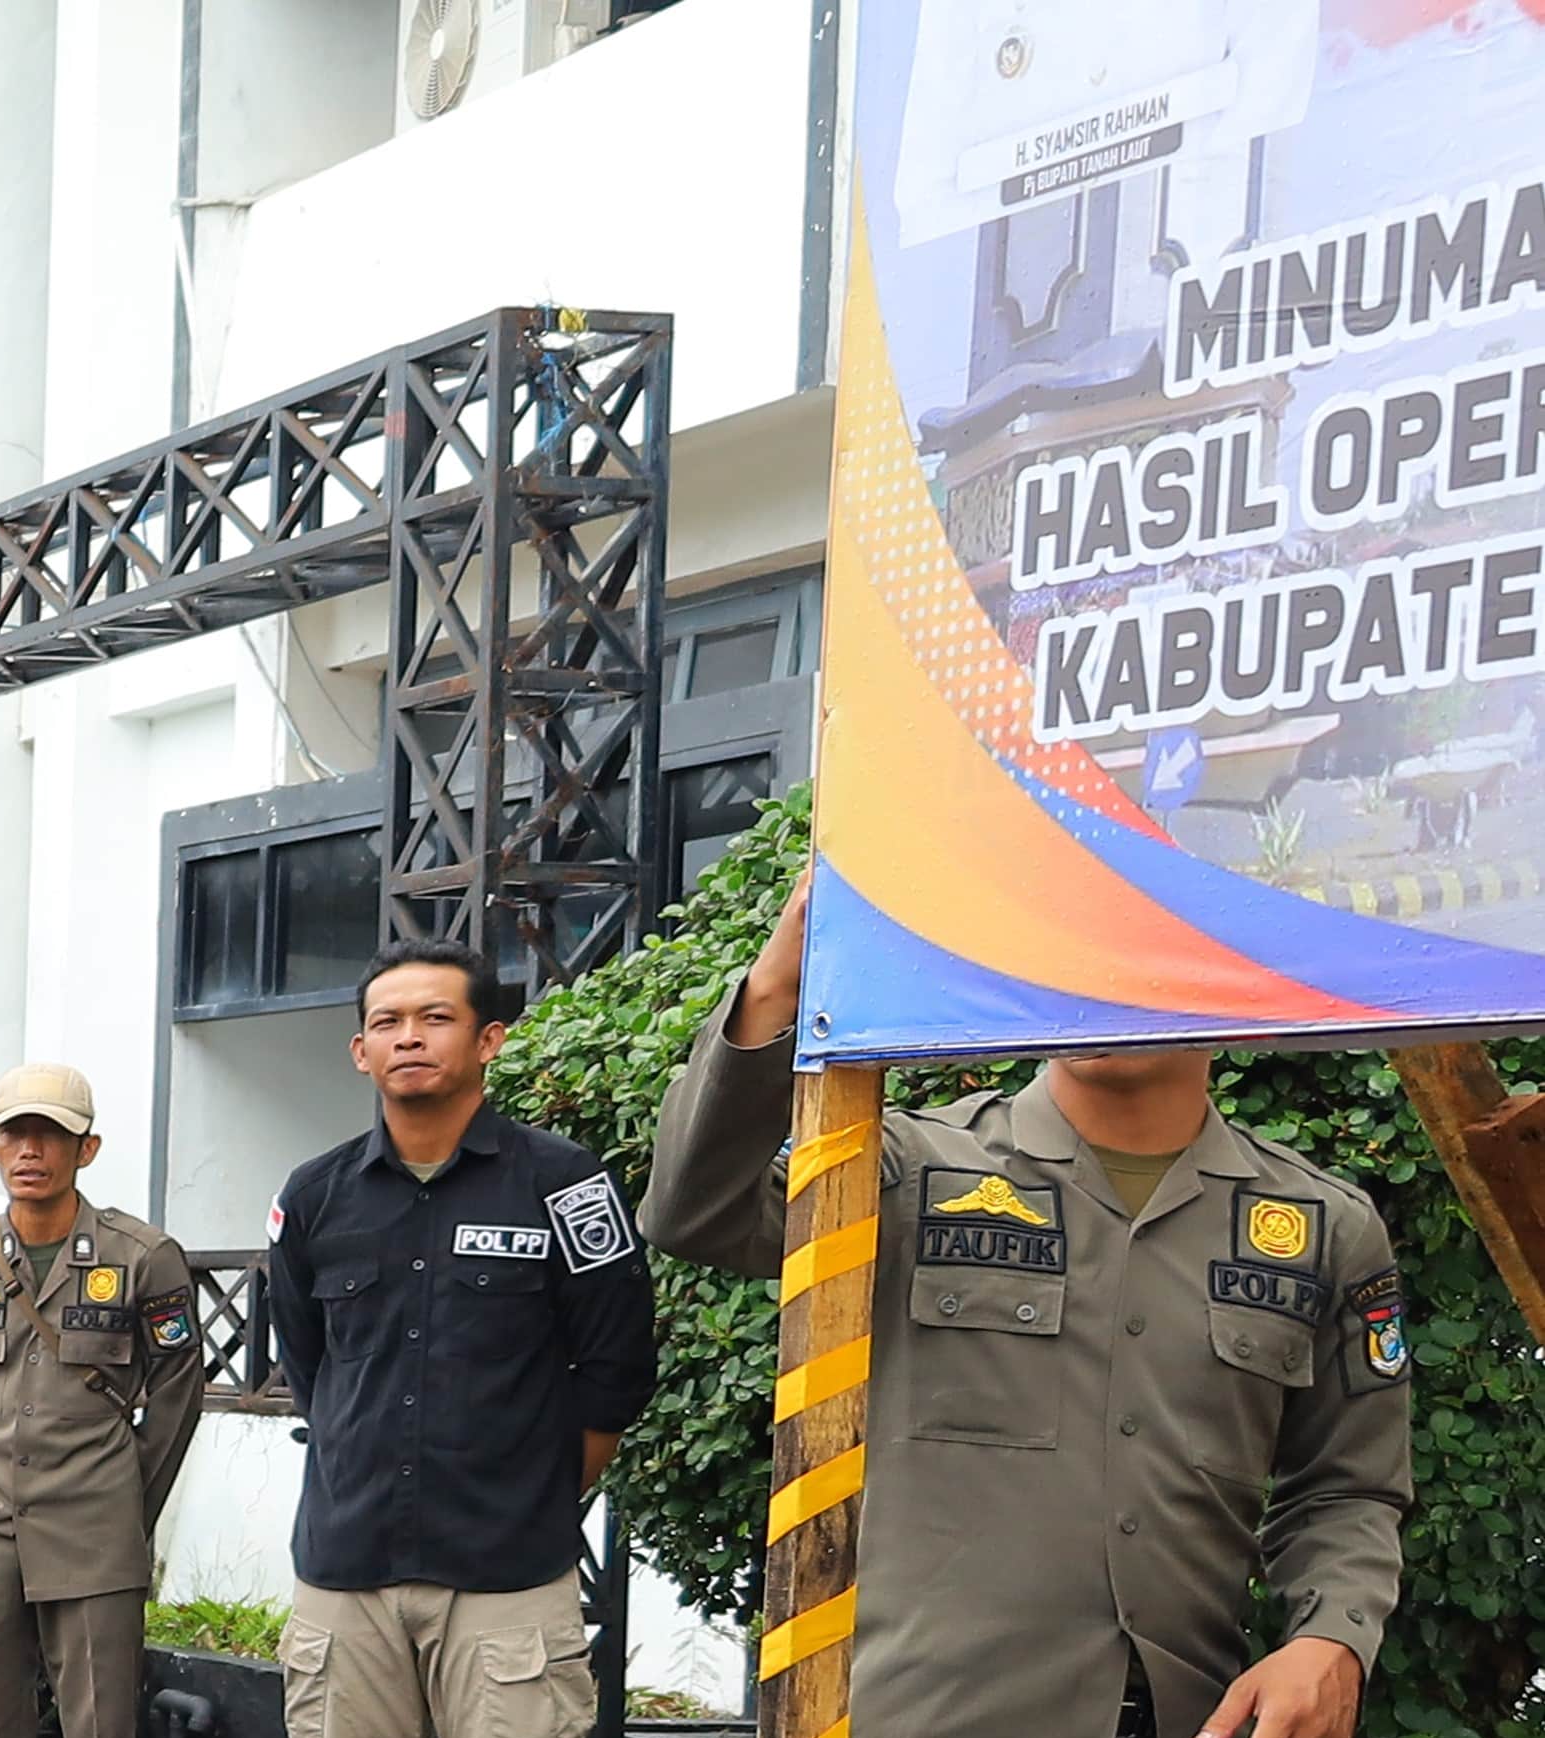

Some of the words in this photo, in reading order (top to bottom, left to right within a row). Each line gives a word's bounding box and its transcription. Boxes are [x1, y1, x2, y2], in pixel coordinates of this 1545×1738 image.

[1034, 116, 1100, 163] SYAMSIR
[1104, 93, 1170, 139] RAHMAN
[1038, 162, 1078, 191] BUPATI
[1119, 137, 1152, 165] LAUT
[1175, 183, 1545, 383] MINUMA
[1021, 430, 1279, 578] HASIL
[1042, 547, 1542, 730] KABUPATE
[461, 1230, 506, 1251] POL
[511, 1233, 542, 1253] PP
[926, 1225, 1057, 1266] TAUFIK
[1217, 1267, 1286, 1305] POL
[67, 1310, 105, 1327] POL
